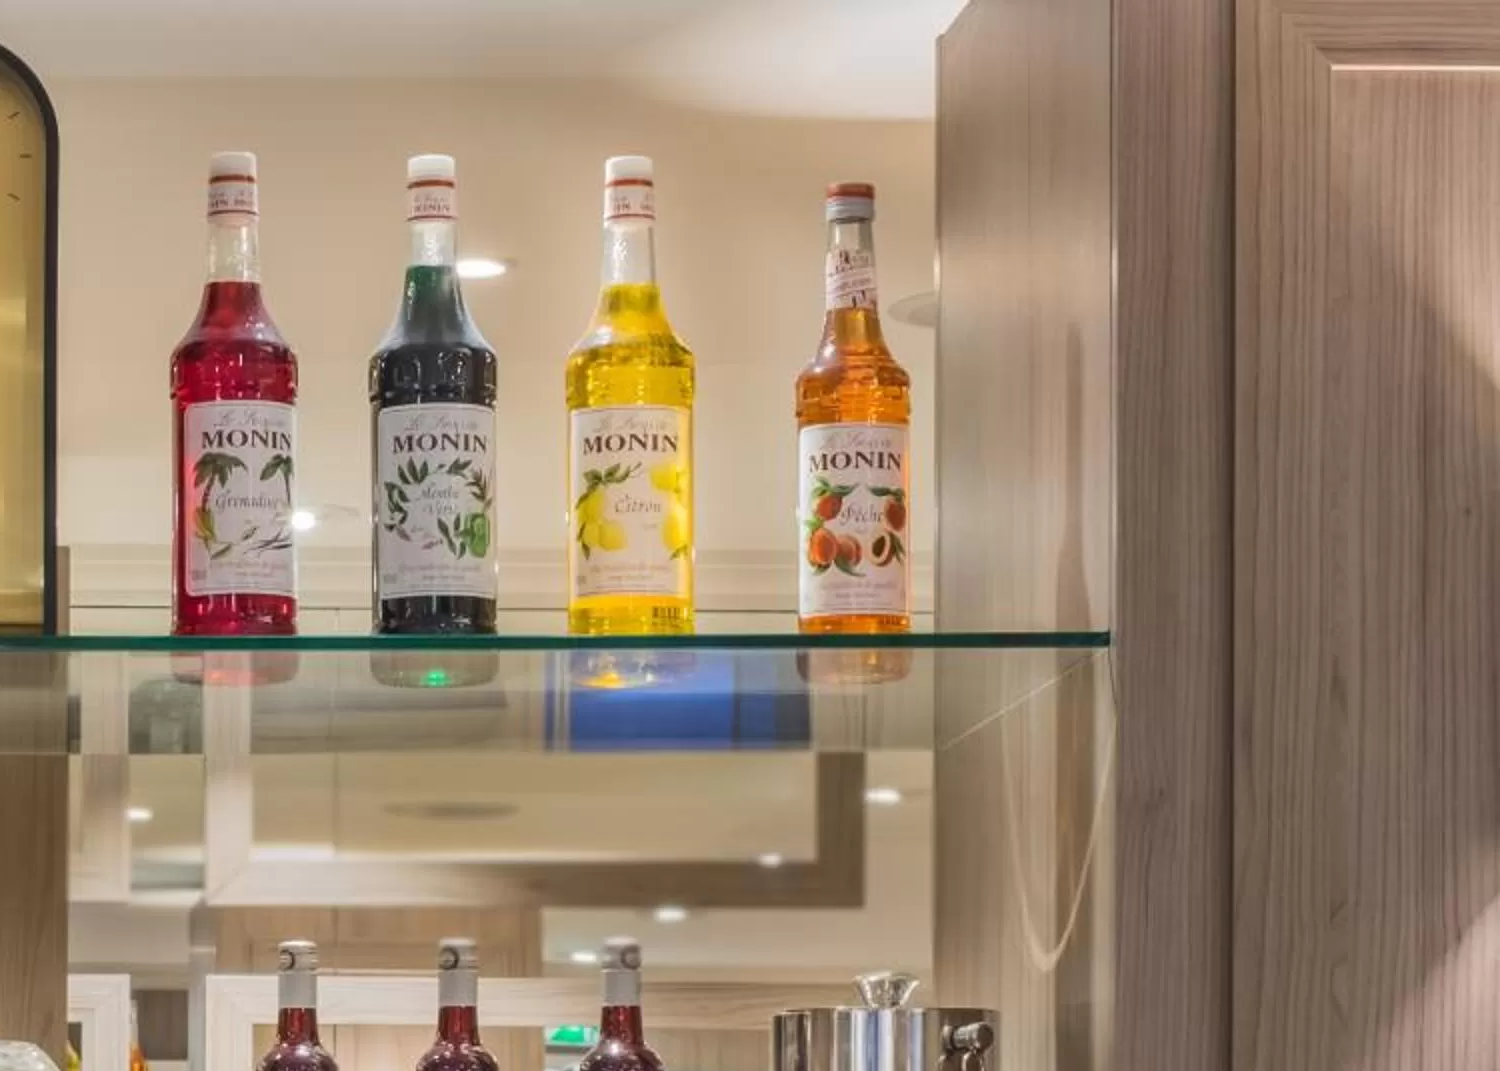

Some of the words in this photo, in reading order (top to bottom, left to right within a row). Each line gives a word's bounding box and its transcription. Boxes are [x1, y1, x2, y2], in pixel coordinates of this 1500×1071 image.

[202, 429, 291, 450] MONIN
[393, 432, 487, 454] MONIN
[583, 433, 679, 455] MONIN
[809, 451, 902, 472] MONIN
